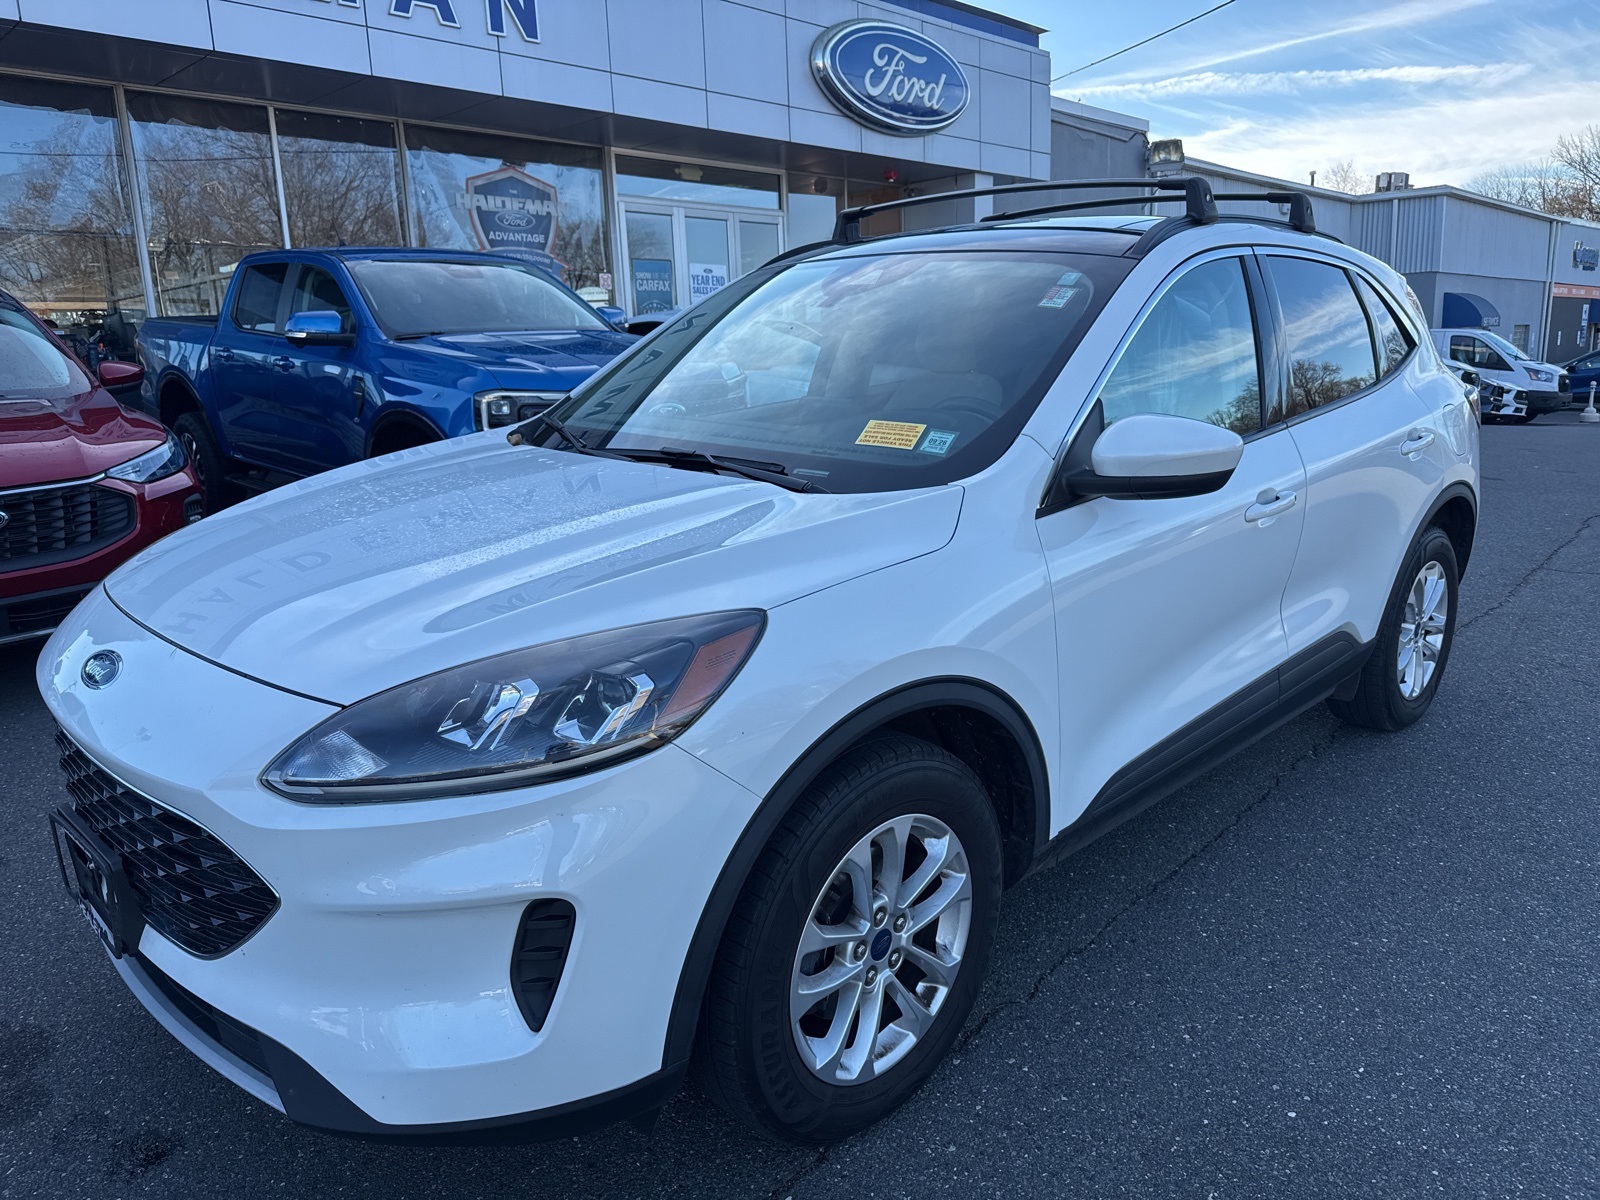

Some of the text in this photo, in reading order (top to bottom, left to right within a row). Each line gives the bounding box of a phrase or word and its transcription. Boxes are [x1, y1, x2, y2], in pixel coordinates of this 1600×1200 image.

[864, 43, 947, 110] Ford
[503, 213, 528, 227] Ford
[488, 230, 545, 243] ADVANTAGE
[635, 272, 652, 280] SHOW
[652, 272, 660, 280] ME
[691, 274, 726, 287] YEAR END
[636, 280, 671, 292] CARFAX
[692, 286, 709, 295] SALES
